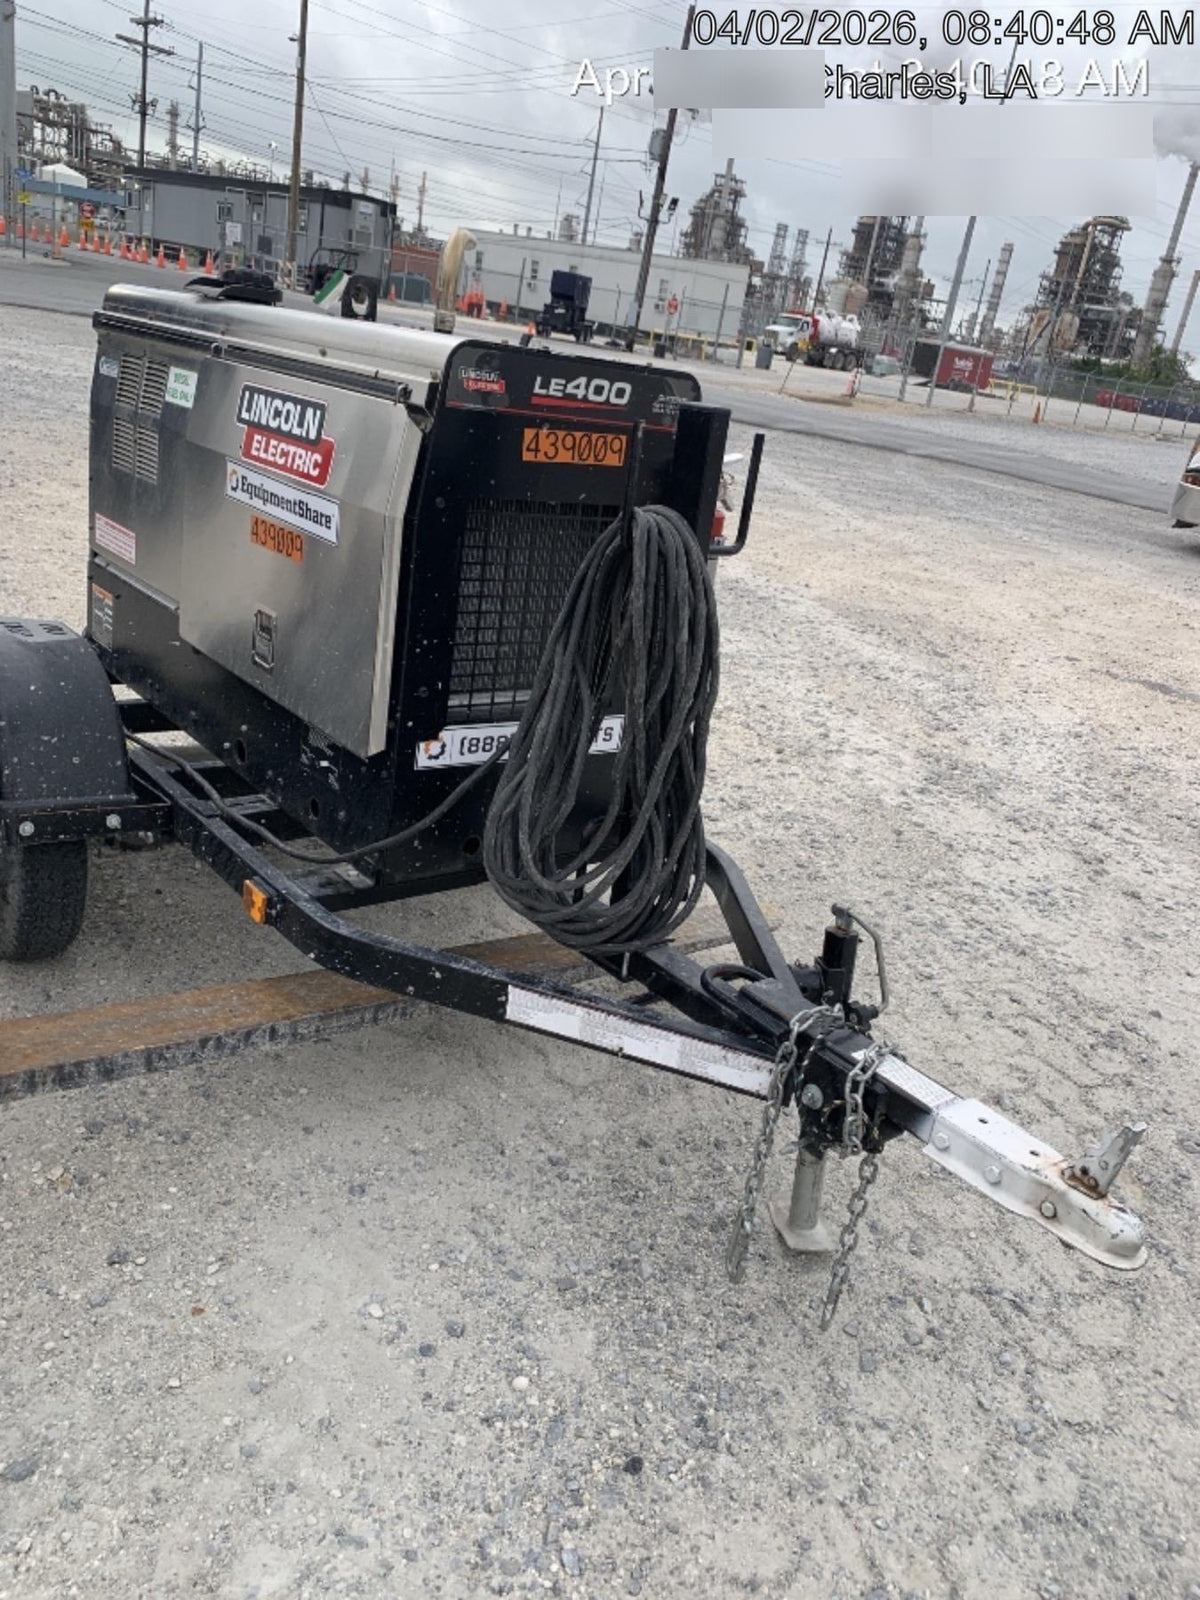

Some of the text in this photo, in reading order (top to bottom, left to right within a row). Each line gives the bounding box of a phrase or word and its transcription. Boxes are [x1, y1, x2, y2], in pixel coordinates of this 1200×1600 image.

[533, 376, 632, 405] LE400
[240, 390, 321, 440] LINCOLN
[250, 434, 323, 478] ELECTRIC
[526, 429, 624, 463] 439009
[240, 475, 333, 530] EquipmentShare
[251, 516, 304, 556] 439009
[459, 735, 511, 756] (888
